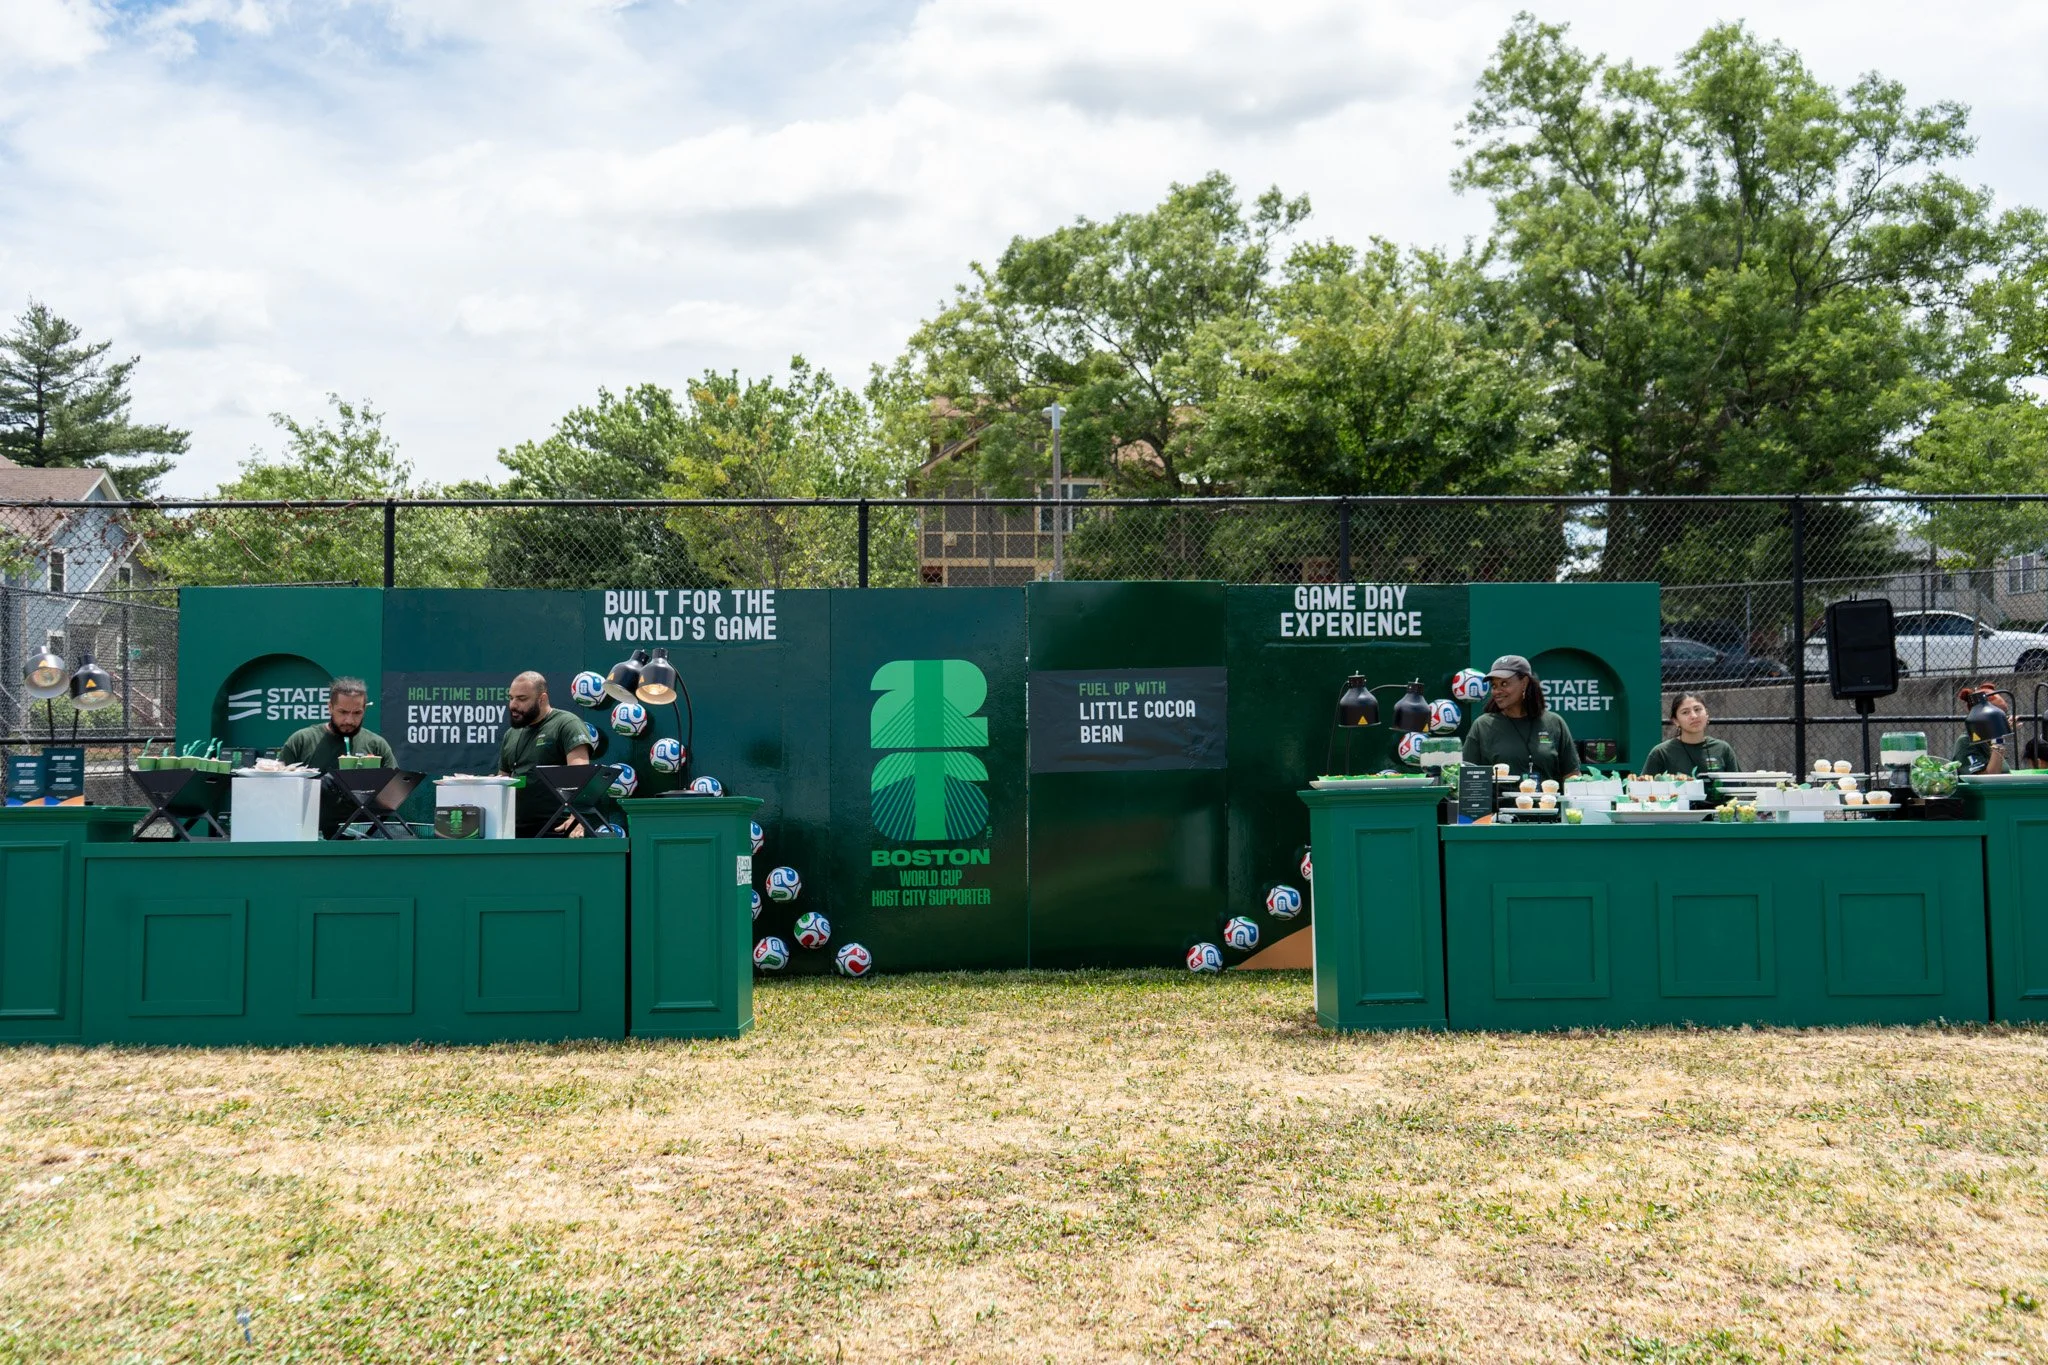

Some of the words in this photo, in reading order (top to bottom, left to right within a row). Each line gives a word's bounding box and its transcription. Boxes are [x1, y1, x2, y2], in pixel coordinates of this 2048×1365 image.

[605, 590, 669, 615] BUILT
[678, 590, 721, 615] FOR
[731, 589, 775, 614] THE
[1294, 585, 1356, 610] GAME
[1365, 585, 1407, 610] DAY
[603, 616, 706, 641] WORLD'S
[715, 615, 777, 640] GAME
[1280, 611, 1422, 637] EXPERIENCE
[266, 687, 331, 703] STATE
[408, 687, 472, 701] HALFTIME
[1079, 682, 1110, 696] FUEL
[1114, 681, 1130, 695] UP
[1135, 681, 1166, 695] WITH
[1539, 679, 1599, 695] STATE
[266, 704, 332, 721] STREE
[407, 705, 507, 723] EVERYBODY
[1079, 701, 1138, 720] LITTLE
[1144, 699, 1196, 719] COCOA
[407, 725, 461, 744] GOTTA
[466, 725, 499, 744] EAT
[1080, 724, 1124, 744] BEAN
[871, 848, 991, 867] BOSTON
[899, 869, 938, 887] WORLD
[941, 869, 963, 886] CUP
[871, 889, 900, 907] HOST
[902, 888, 927, 906] CITY
[928, 888, 991, 906] SUPPORTER
